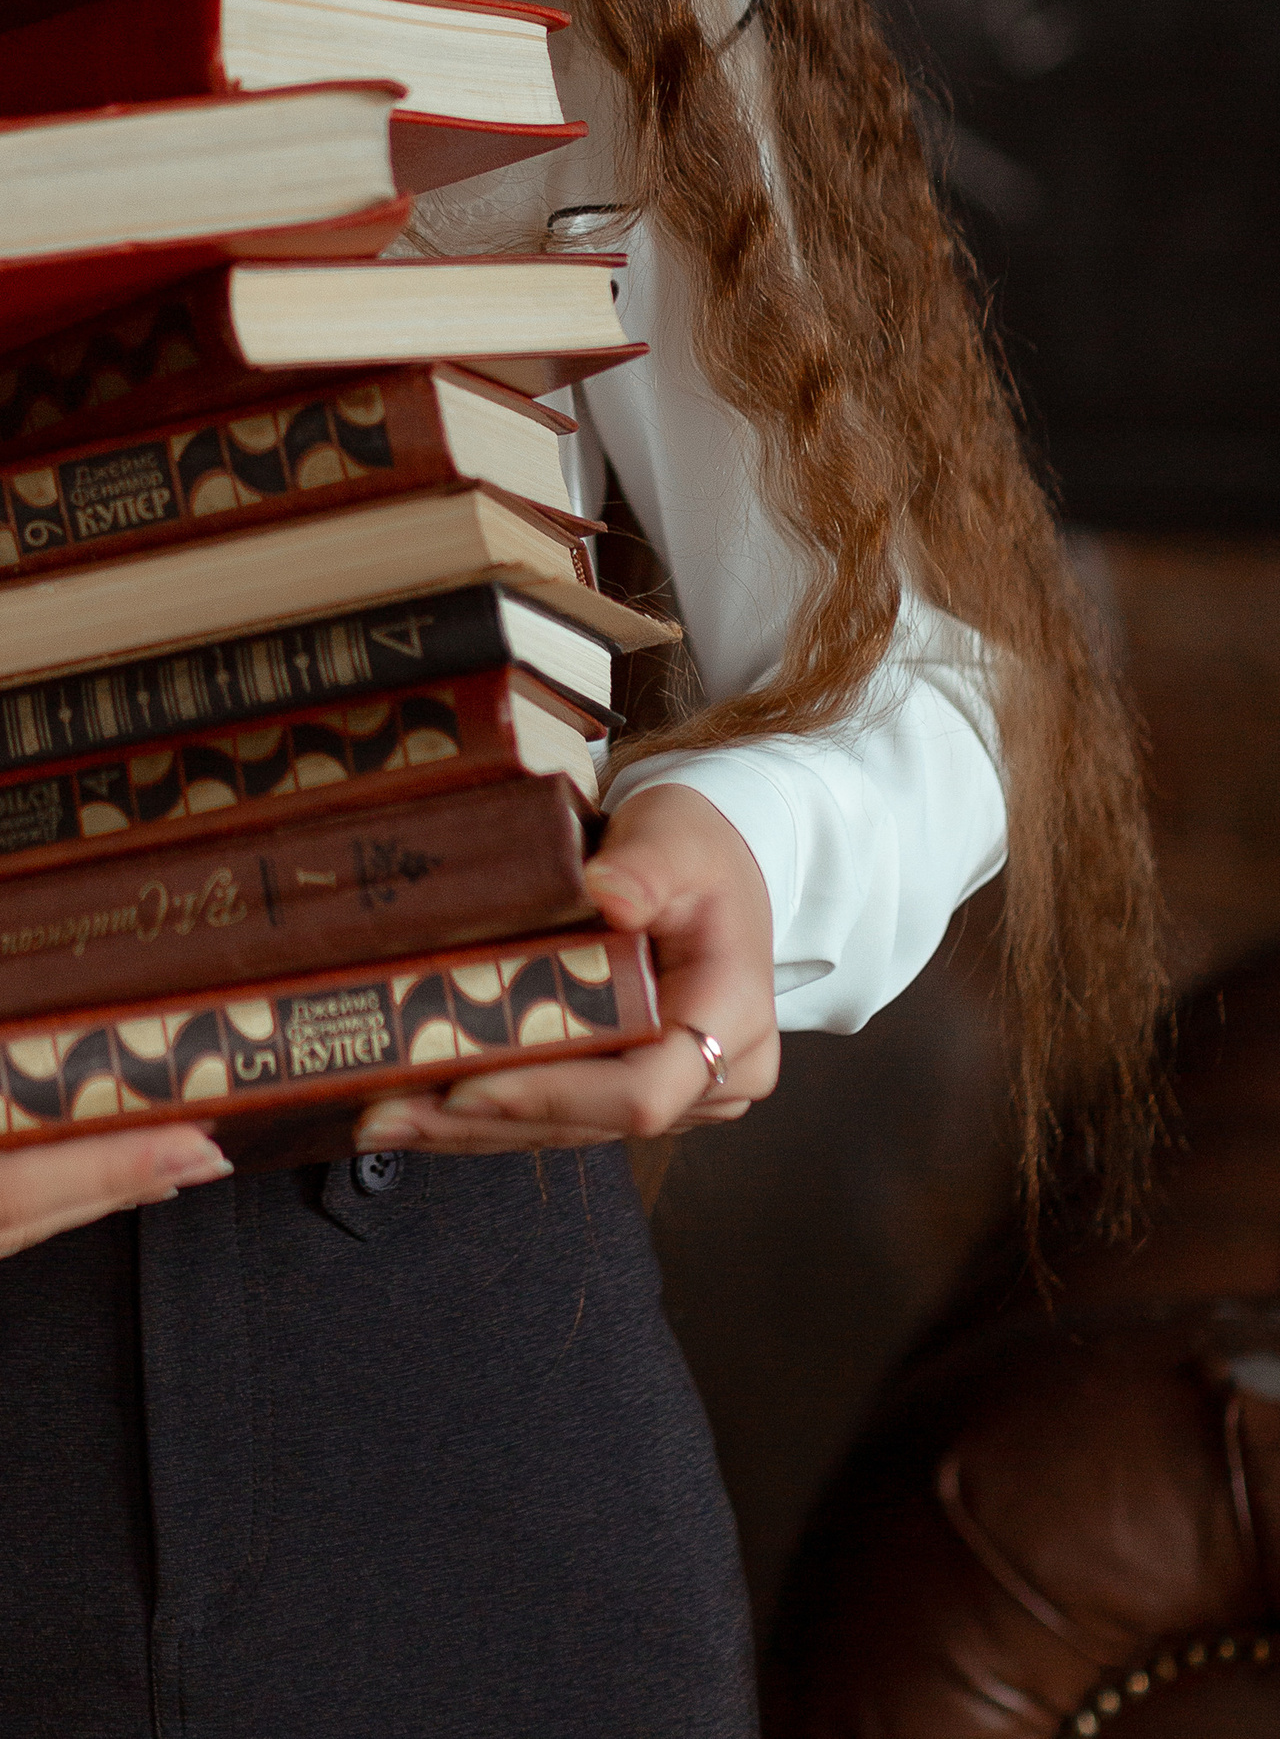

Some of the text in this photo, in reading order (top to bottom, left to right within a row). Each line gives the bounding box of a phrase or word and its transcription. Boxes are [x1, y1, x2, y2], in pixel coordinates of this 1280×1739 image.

[75, 487, 170, 537] КУПЕР
[370, 614, 435, 659] 4
[81, 769, 121, 797] 4
[234, 1048, 277, 1081] 5
[290, 1028, 391, 1076] КУПЕР
